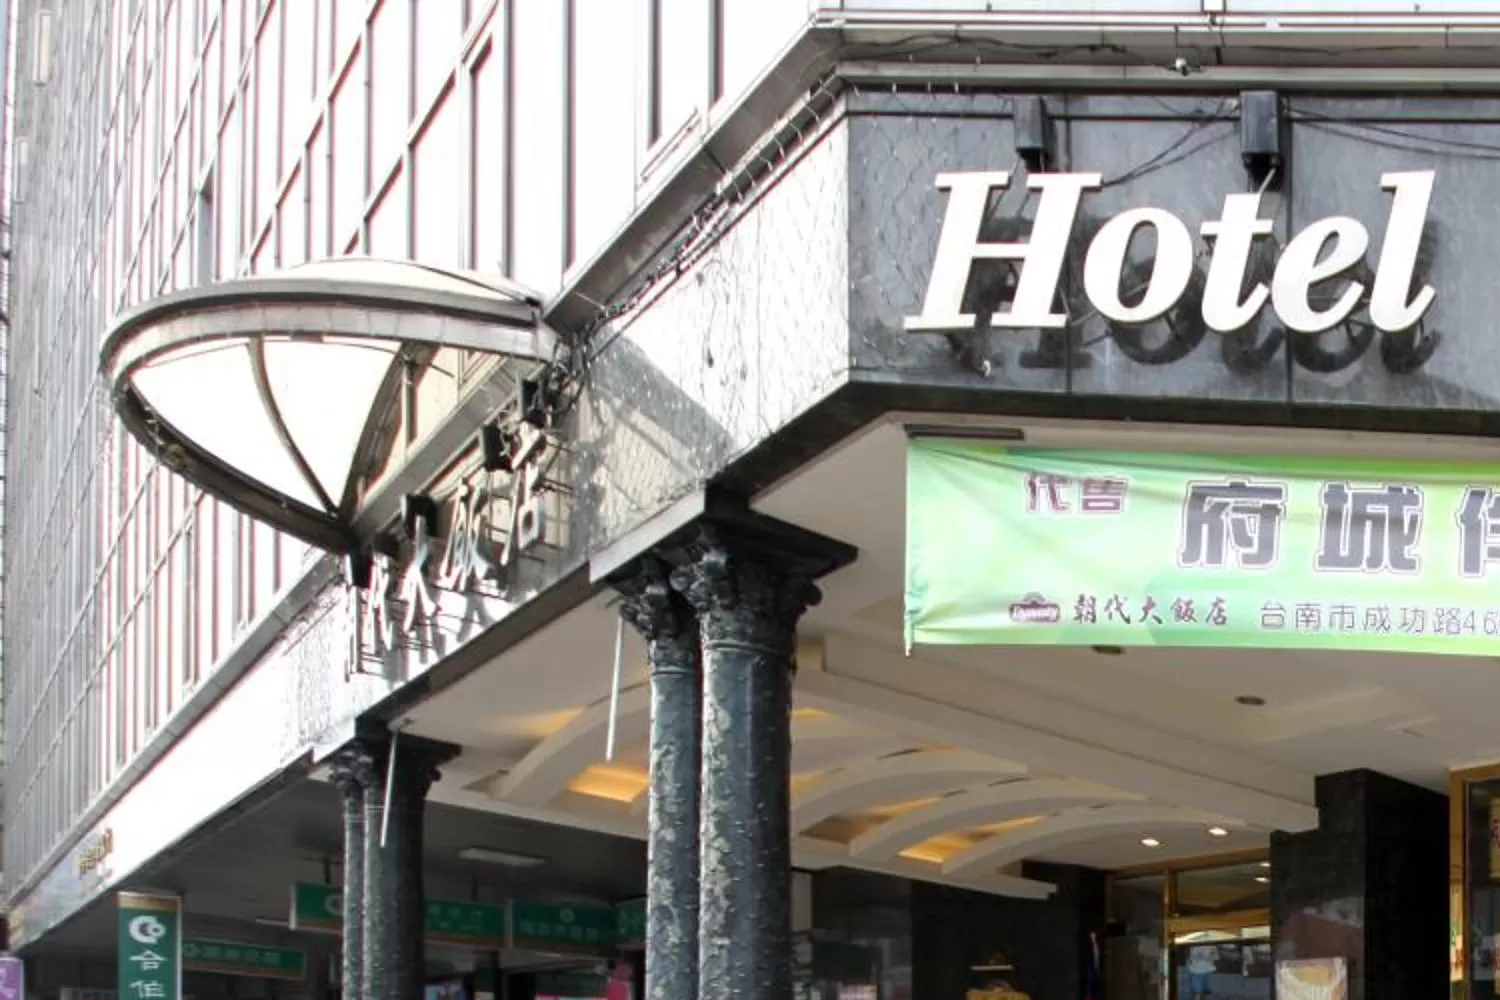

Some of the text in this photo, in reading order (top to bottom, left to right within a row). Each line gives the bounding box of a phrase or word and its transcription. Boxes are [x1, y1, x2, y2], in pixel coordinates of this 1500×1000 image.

[903, 170, 1437, 333] Hotel
[1073, 593, 1227, 625] 朝代大飯店
